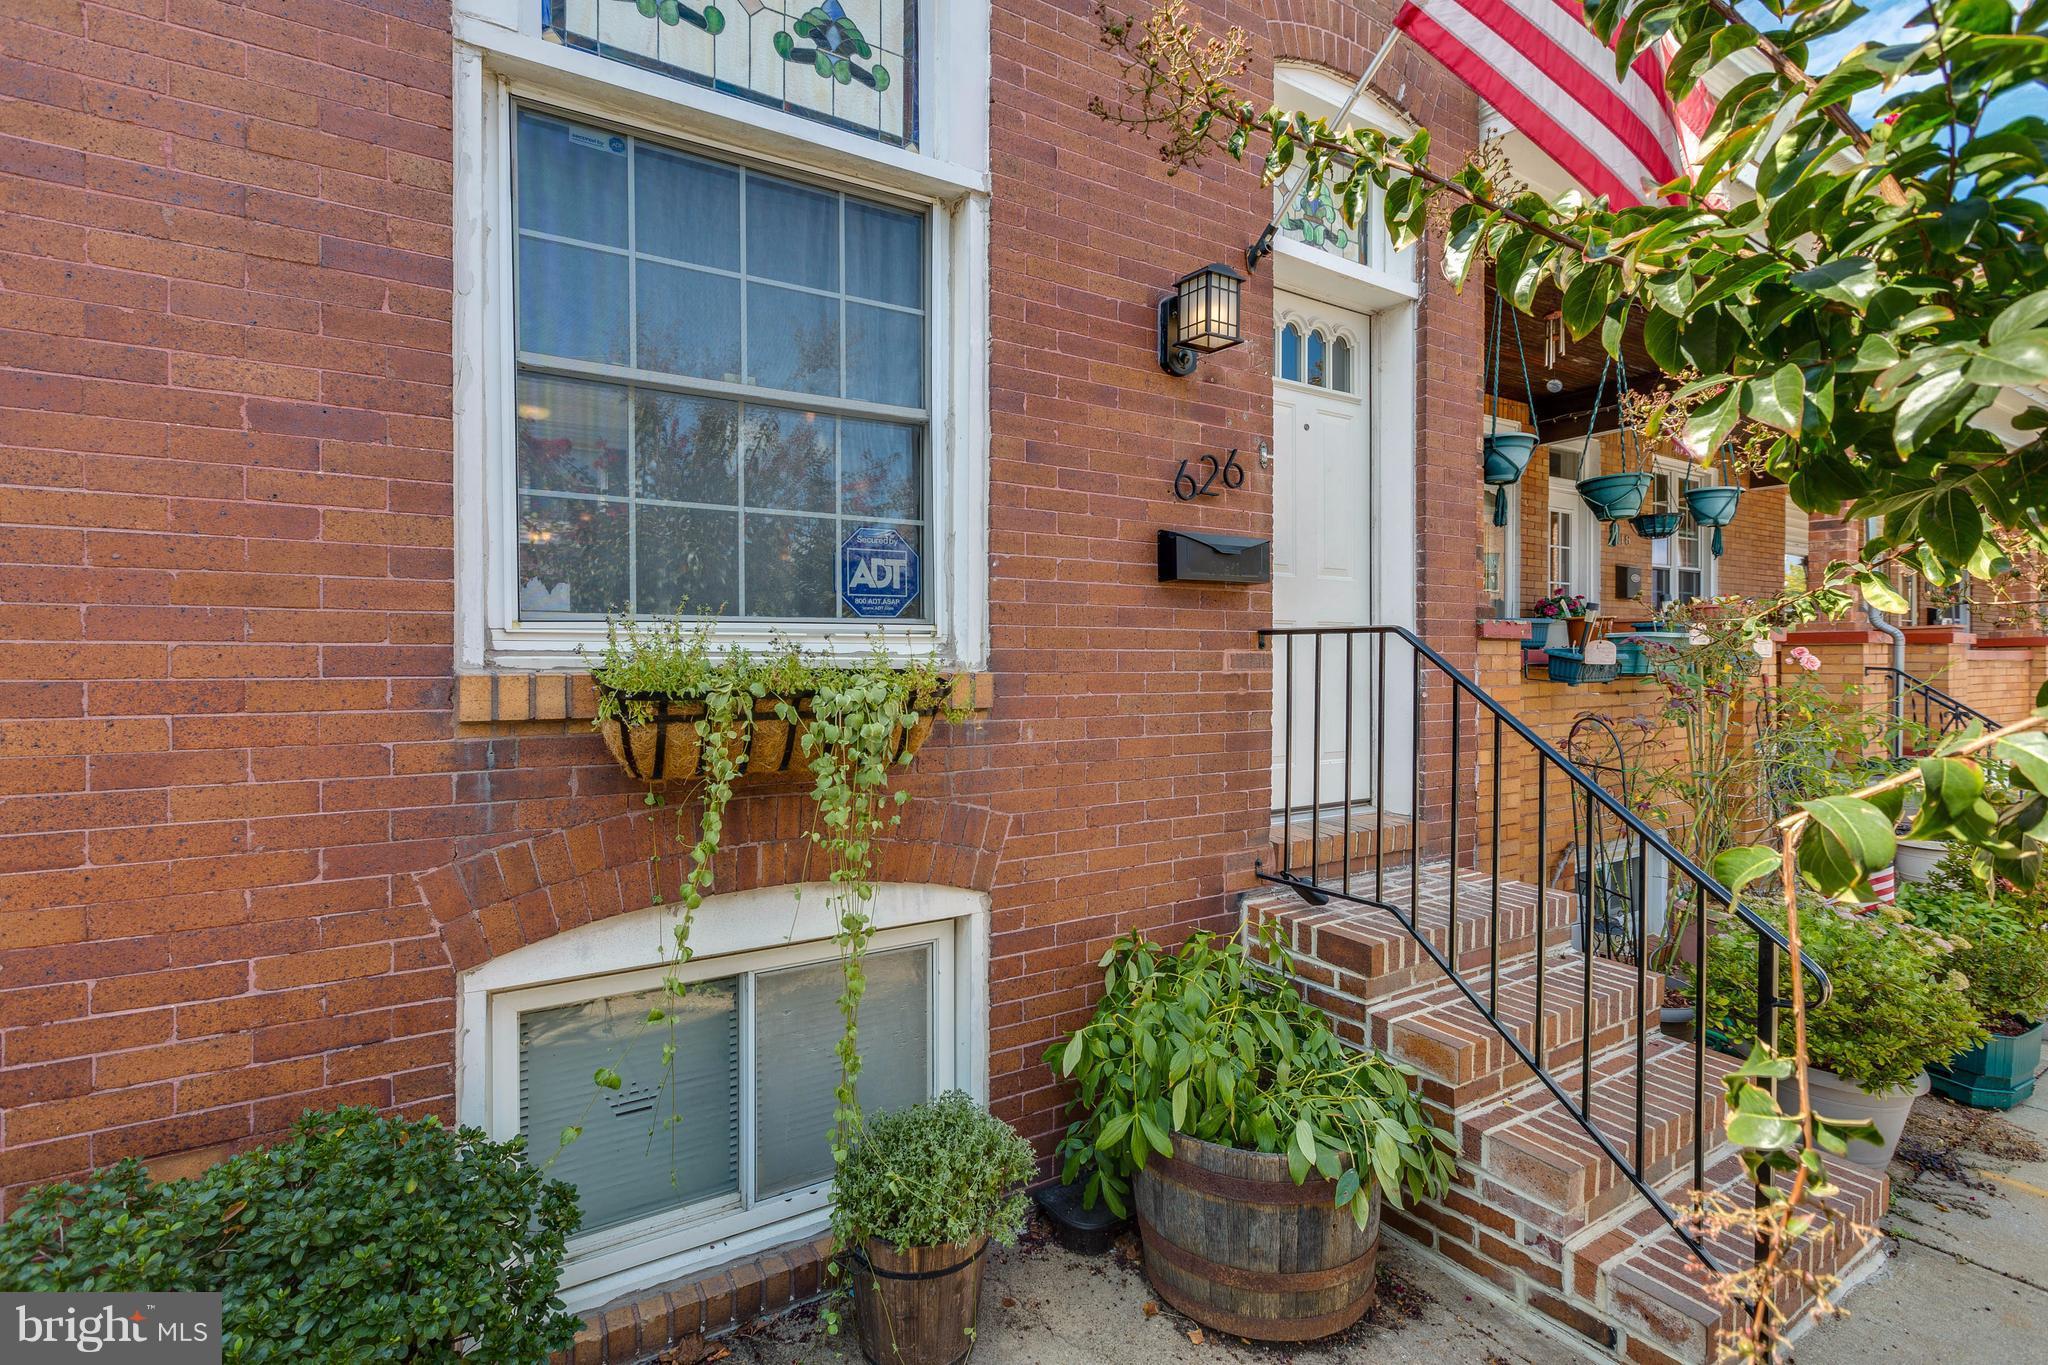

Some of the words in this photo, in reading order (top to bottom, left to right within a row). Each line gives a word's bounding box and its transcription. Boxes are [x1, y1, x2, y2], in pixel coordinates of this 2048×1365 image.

[1174, 448, 1245, 501] 626
[856, 535, 888, 544] Secured
[889, 536, 898, 546] by
[849, 557, 907, 589] ADT
